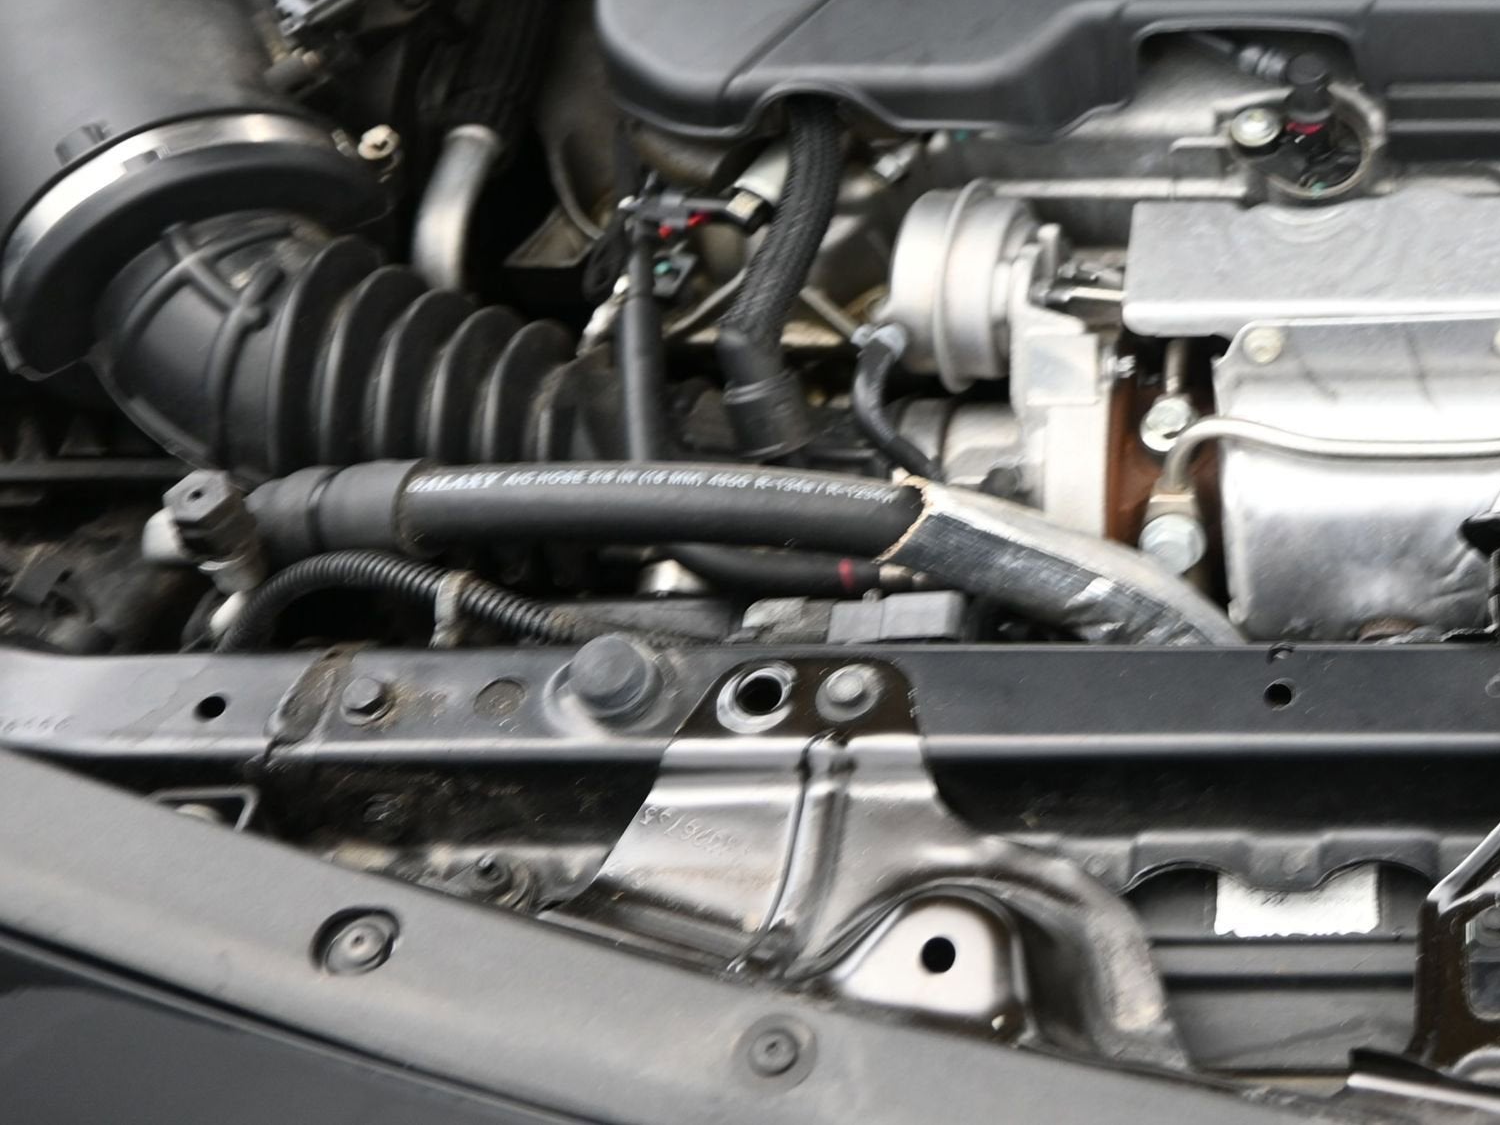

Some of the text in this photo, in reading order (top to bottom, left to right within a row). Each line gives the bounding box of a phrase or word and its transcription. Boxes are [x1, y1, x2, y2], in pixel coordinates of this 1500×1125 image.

[406, 470, 505, 492] GALAXY
[534, 470, 589, 485] HOSE
[616, 469, 639, 484] IN
